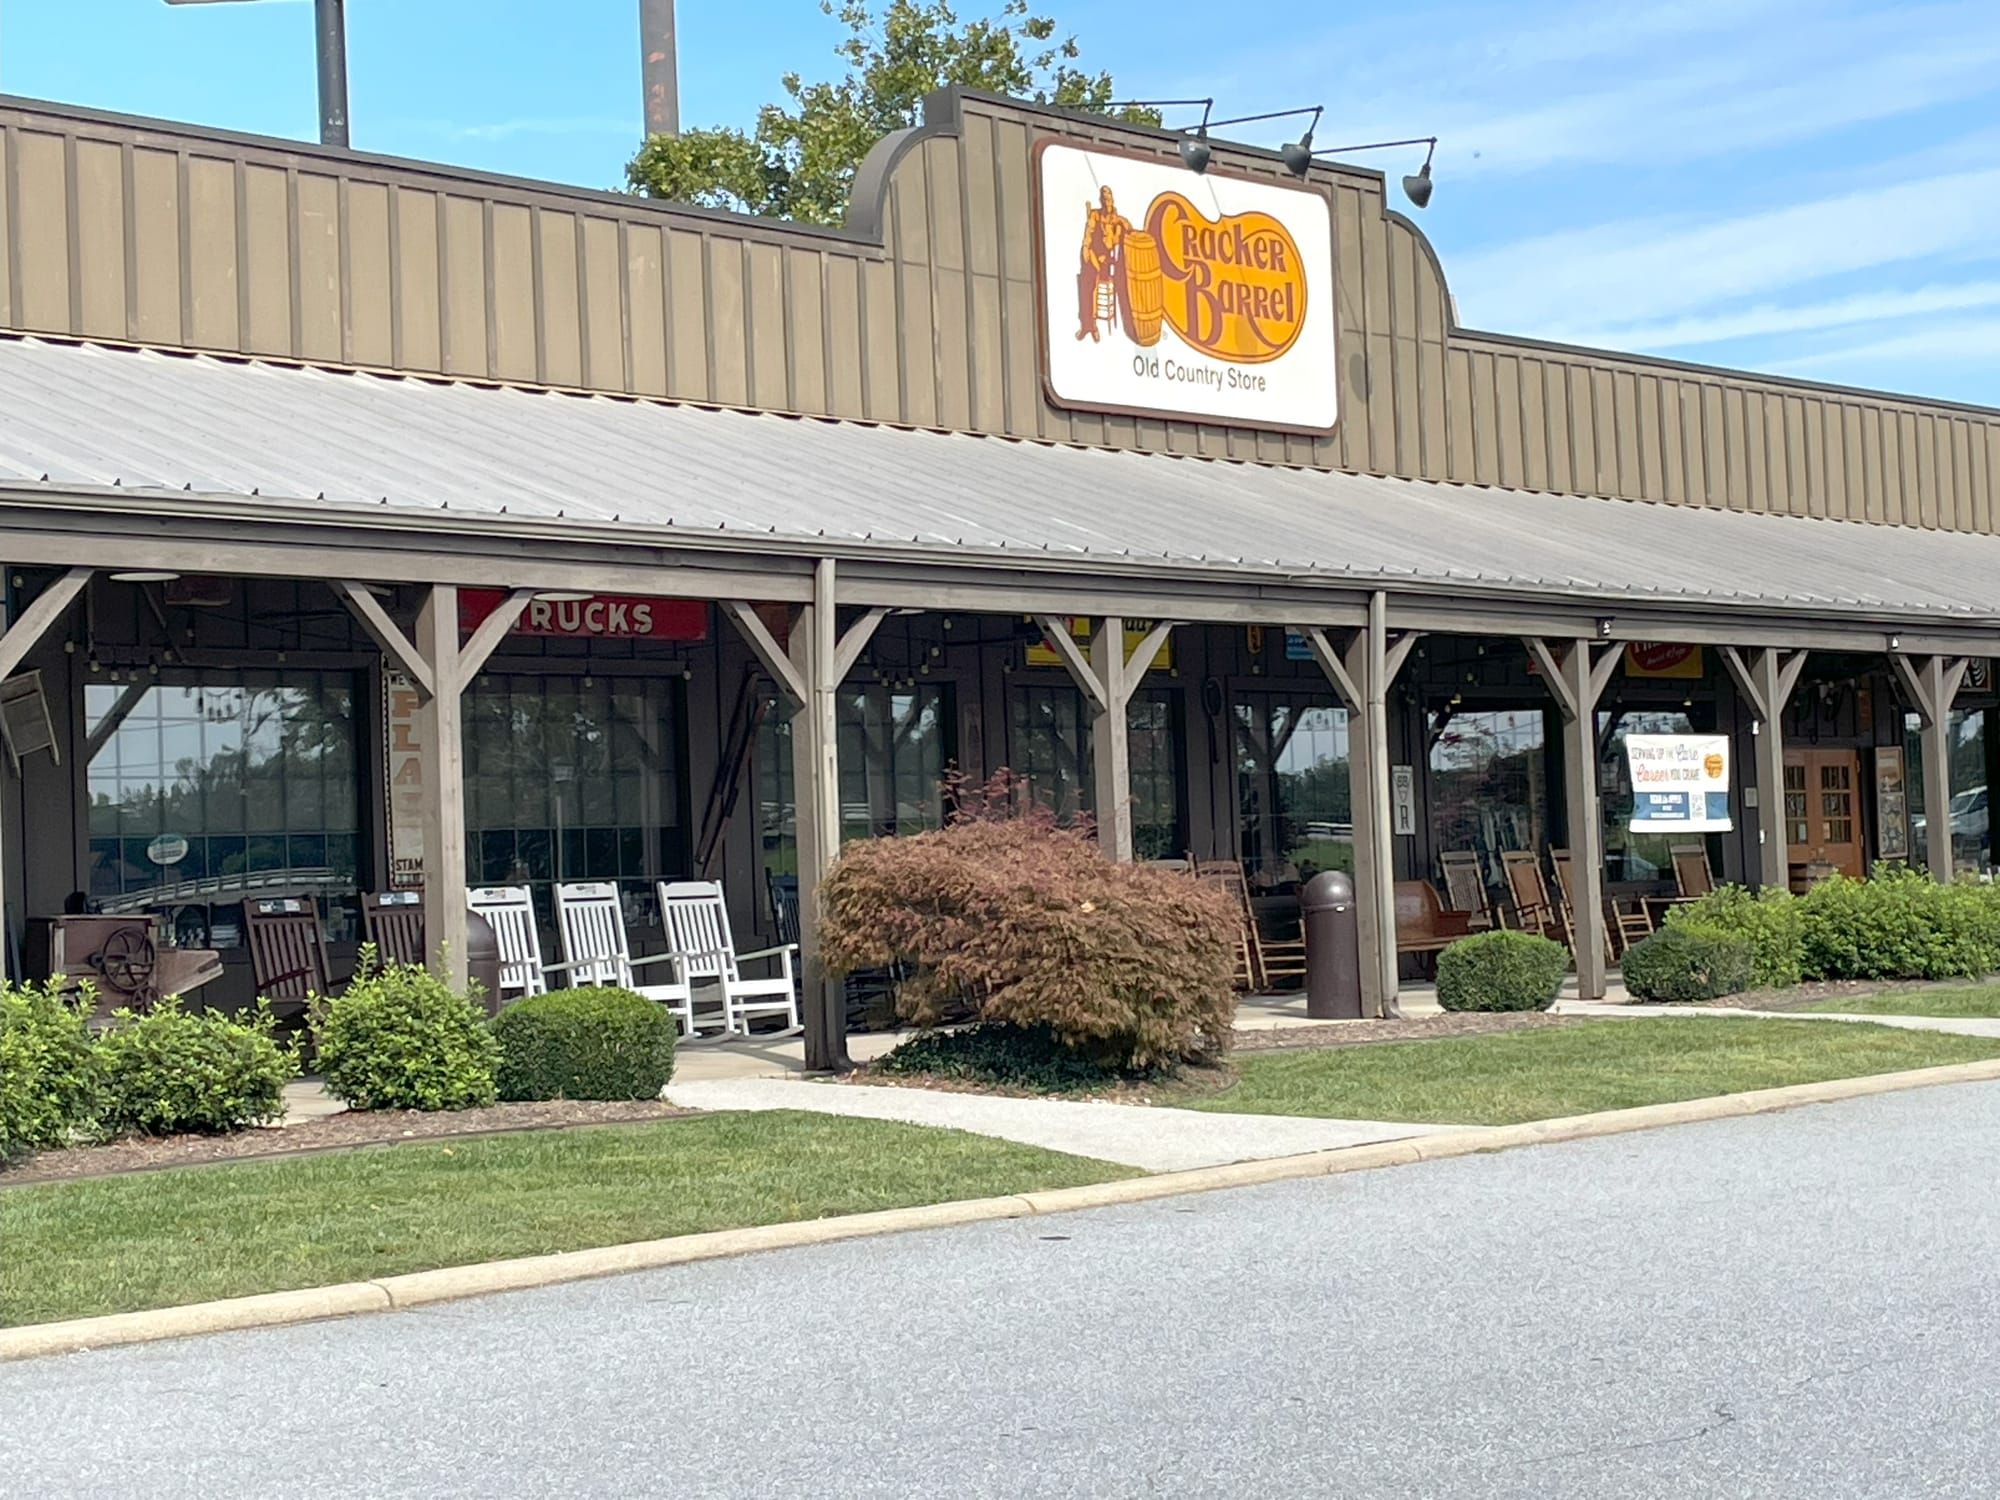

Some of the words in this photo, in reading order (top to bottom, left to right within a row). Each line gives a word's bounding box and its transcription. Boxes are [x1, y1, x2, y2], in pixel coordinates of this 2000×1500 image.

[1133, 354, 1159, 379] Old
[1165, 359, 1223, 392] Country
[1227, 367, 1266, 392] Store
[513, 600, 653, 634] RUCKS
